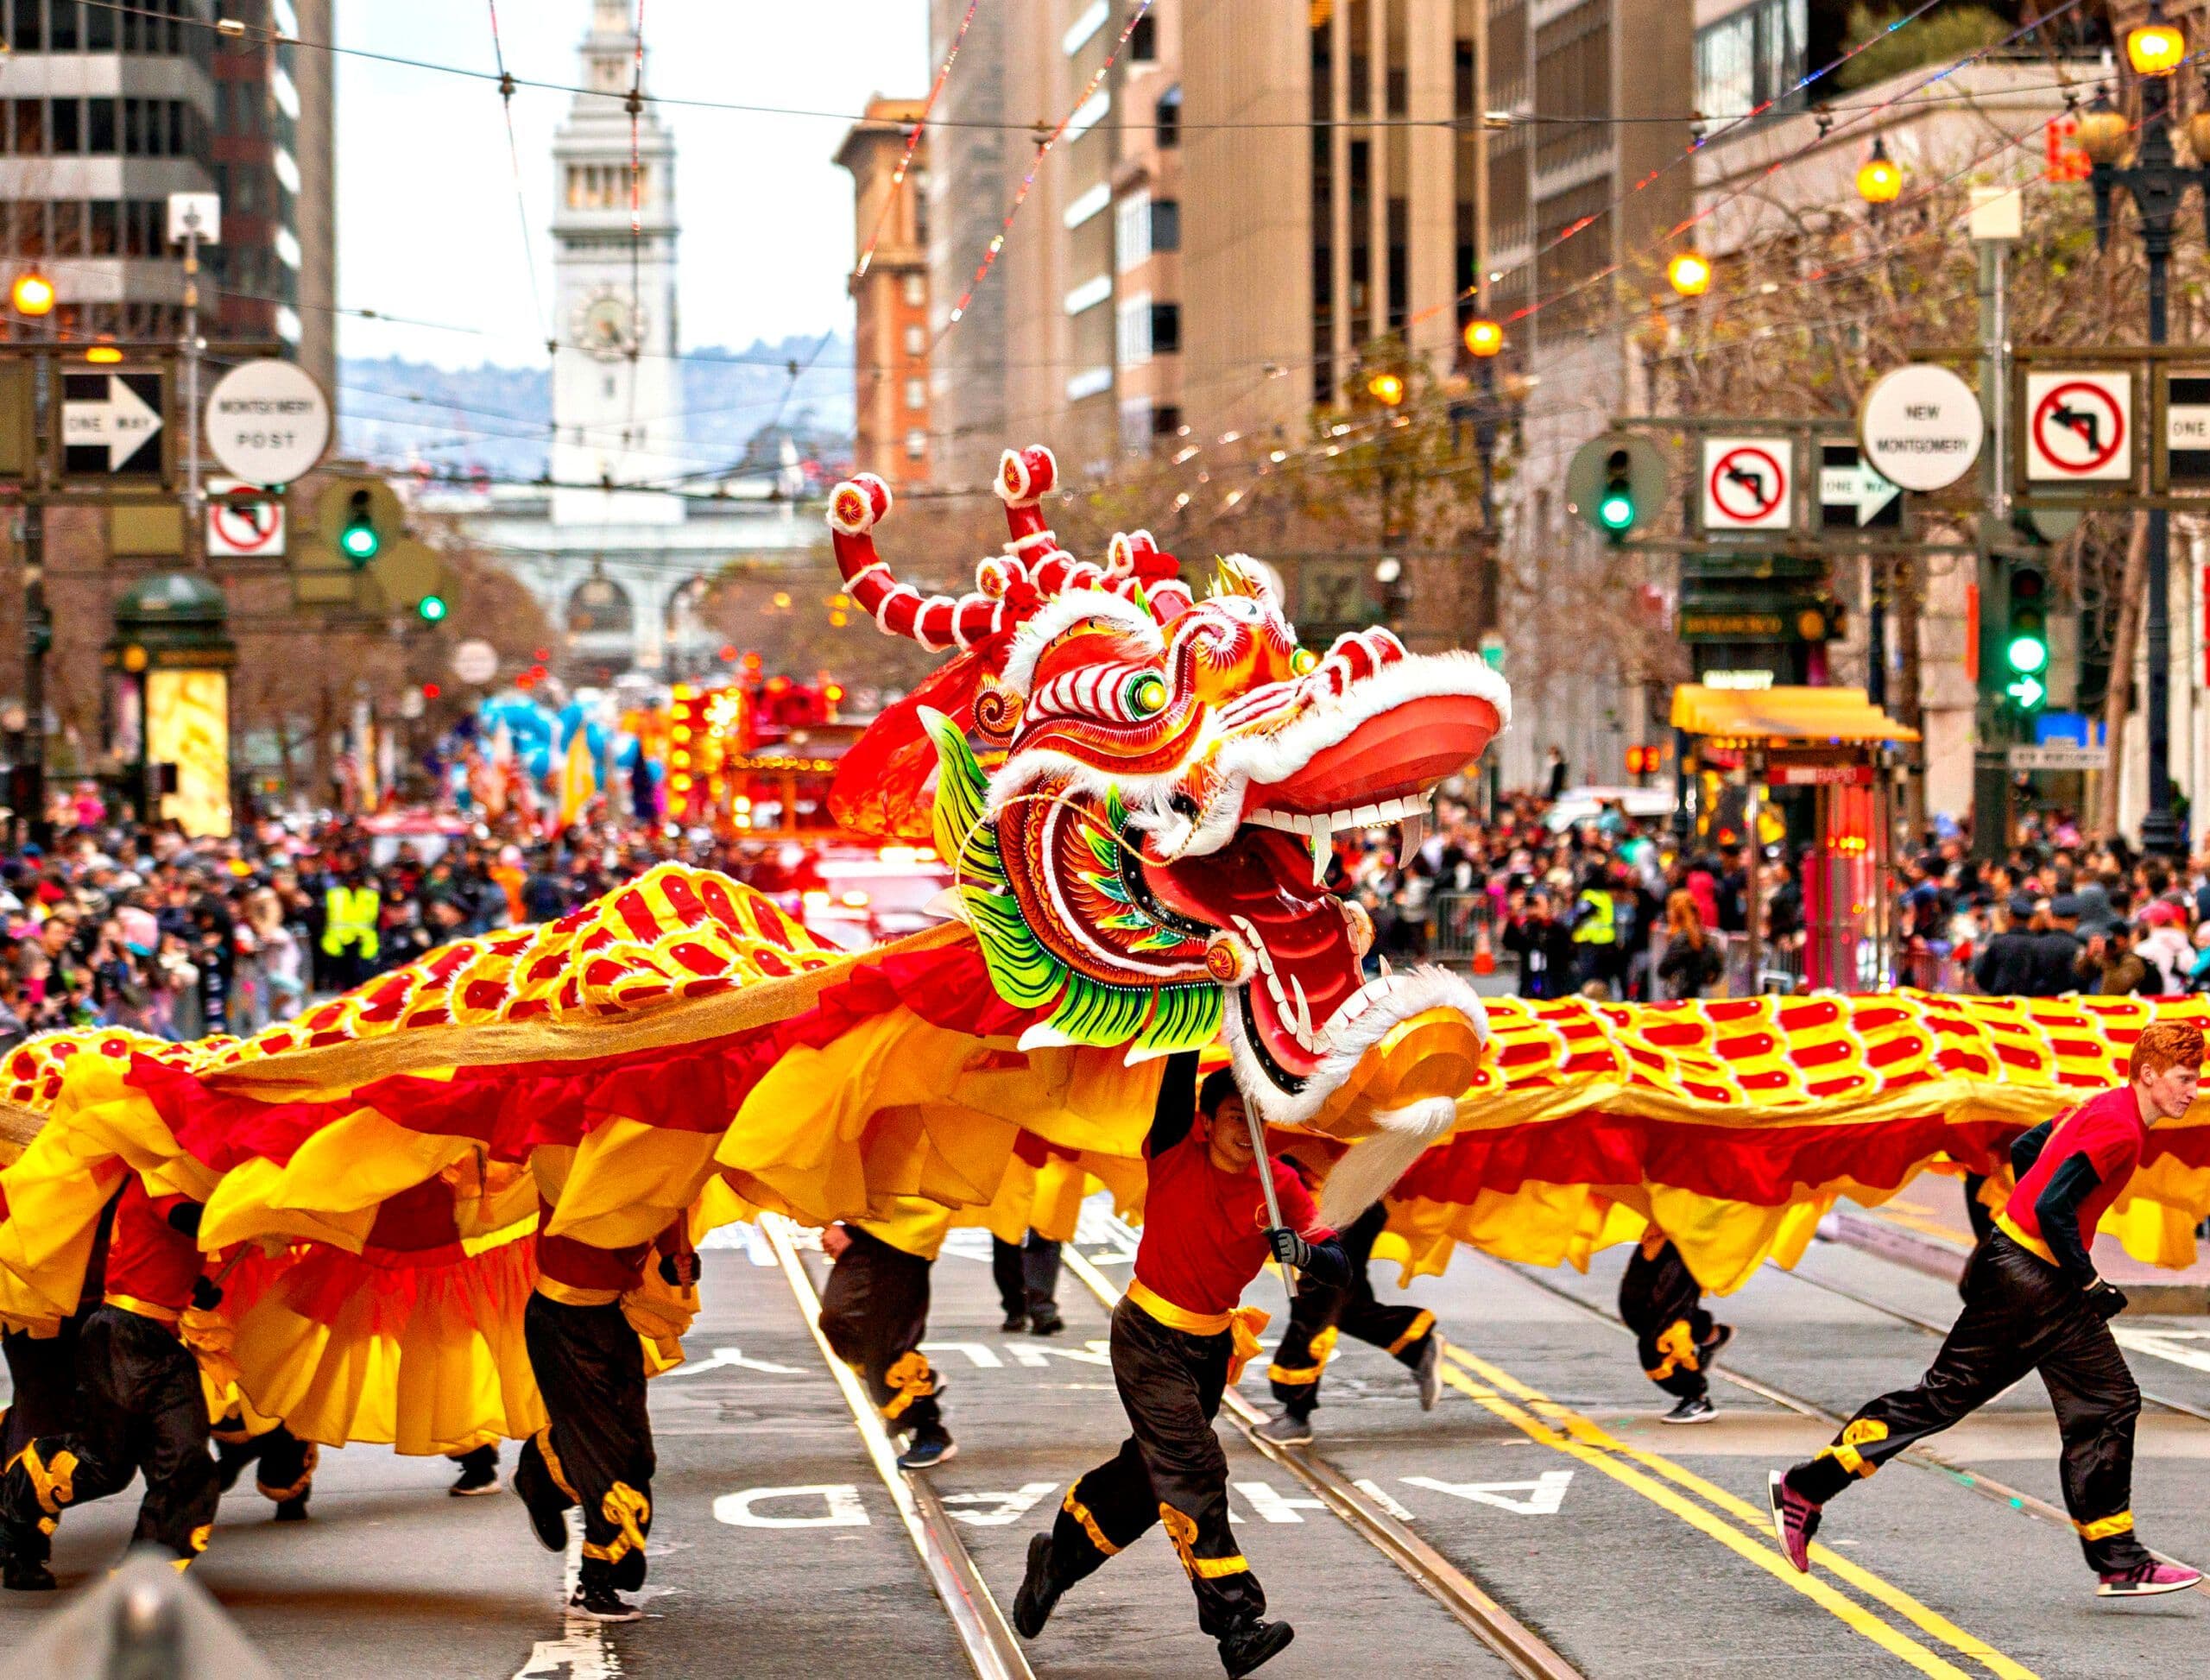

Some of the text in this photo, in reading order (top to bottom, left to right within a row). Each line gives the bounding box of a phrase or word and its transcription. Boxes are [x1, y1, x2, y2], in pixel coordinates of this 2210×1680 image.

[1905, 405, 1941, 420] NEW
[67, 417, 151, 433] ONE WAY
[2173, 420, 2206, 437] ONE
[237, 432, 296, 448] POST
[1877, 438, 1969, 454] MONTGOMERY
[1826, 481, 1852, 492] ONE
